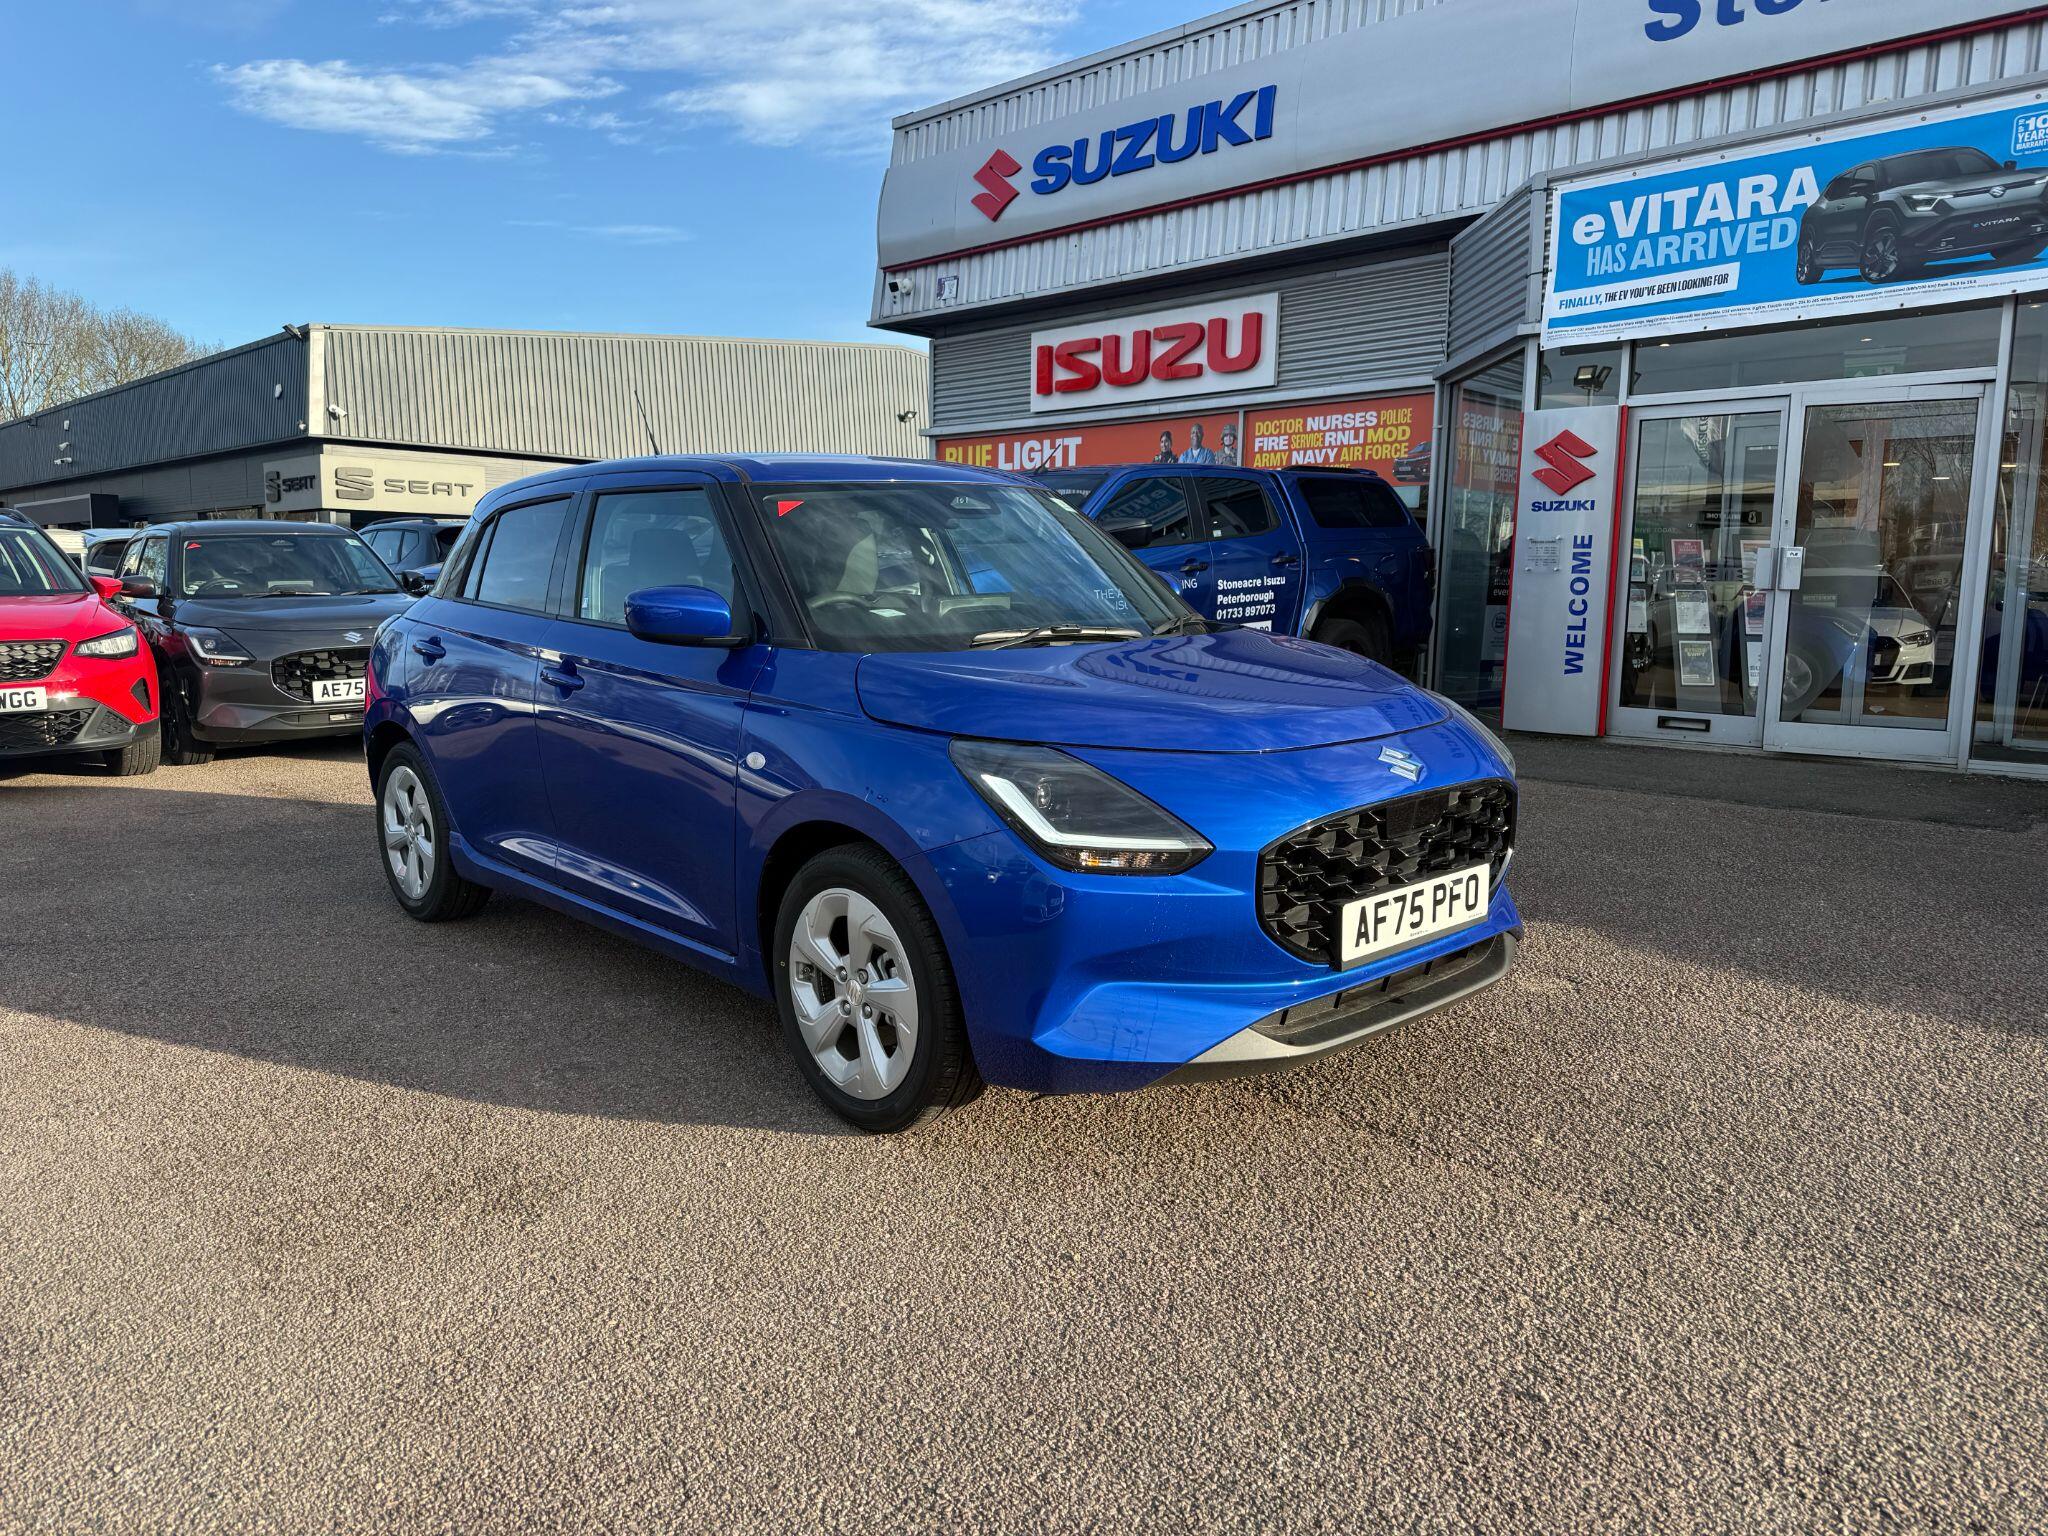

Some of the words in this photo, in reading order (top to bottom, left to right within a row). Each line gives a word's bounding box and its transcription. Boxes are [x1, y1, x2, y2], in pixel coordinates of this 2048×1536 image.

[1030, 84, 1277, 195] SUZUKI
[1586, 242, 1627, 277] HAS
[1629, 216, 1798, 271] ARRIVED
[1559, 293, 1603, 310] FINALLY,
[1604, 291, 1618, 303] THE
[1618, 290, 1628, 301] EV
[1657, 282, 1677, 294] BEEN
[1678, 276, 1712, 292] LOOKING
[1712, 273, 1730, 285] FOR
[1036, 311, 1263, 396] ISUZU
[1255, 418, 1303, 436] DOCTOR
[1306, 411, 1378, 432] NURSES
[1380, 408, 1413, 425] POLICE
[1254, 435, 1289, 453] FIRE
[1290, 432, 1324, 450] SERVICE
[1324, 429, 1365, 447] RNLI
[1367, 426, 1411, 443] MOD
[998, 436, 1082, 471] LIGHT
[1253, 451, 1289, 468] ARMY
[1291, 448, 1338, 465] NAVY
[1340, 445, 1363, 462] AIR
[1365, 442, 1409, 460] FORCE
[282, 475, 316, 492] SEAT
[384, 478, 474, 497] SEAT
[1531, 498, 1596, 513] SUZUKI
[1093, 588, 1114, 600] THE
[1217, 577, 1262, 591] Stoneacre
[1264, 575, 1286, 587] Isuzu
[1217, 590, 1275, 605] Peterborough
[1564, 534, 1593, 675] WELCOME
[1216, 608, 1243, 620] 01733
[1245, 604, 1276, 617] 897073
[321, 681, 364, 698] AE75
[1355, 888, 1425, 948] AF75
[1432, 873, 1480, 923] PFO
